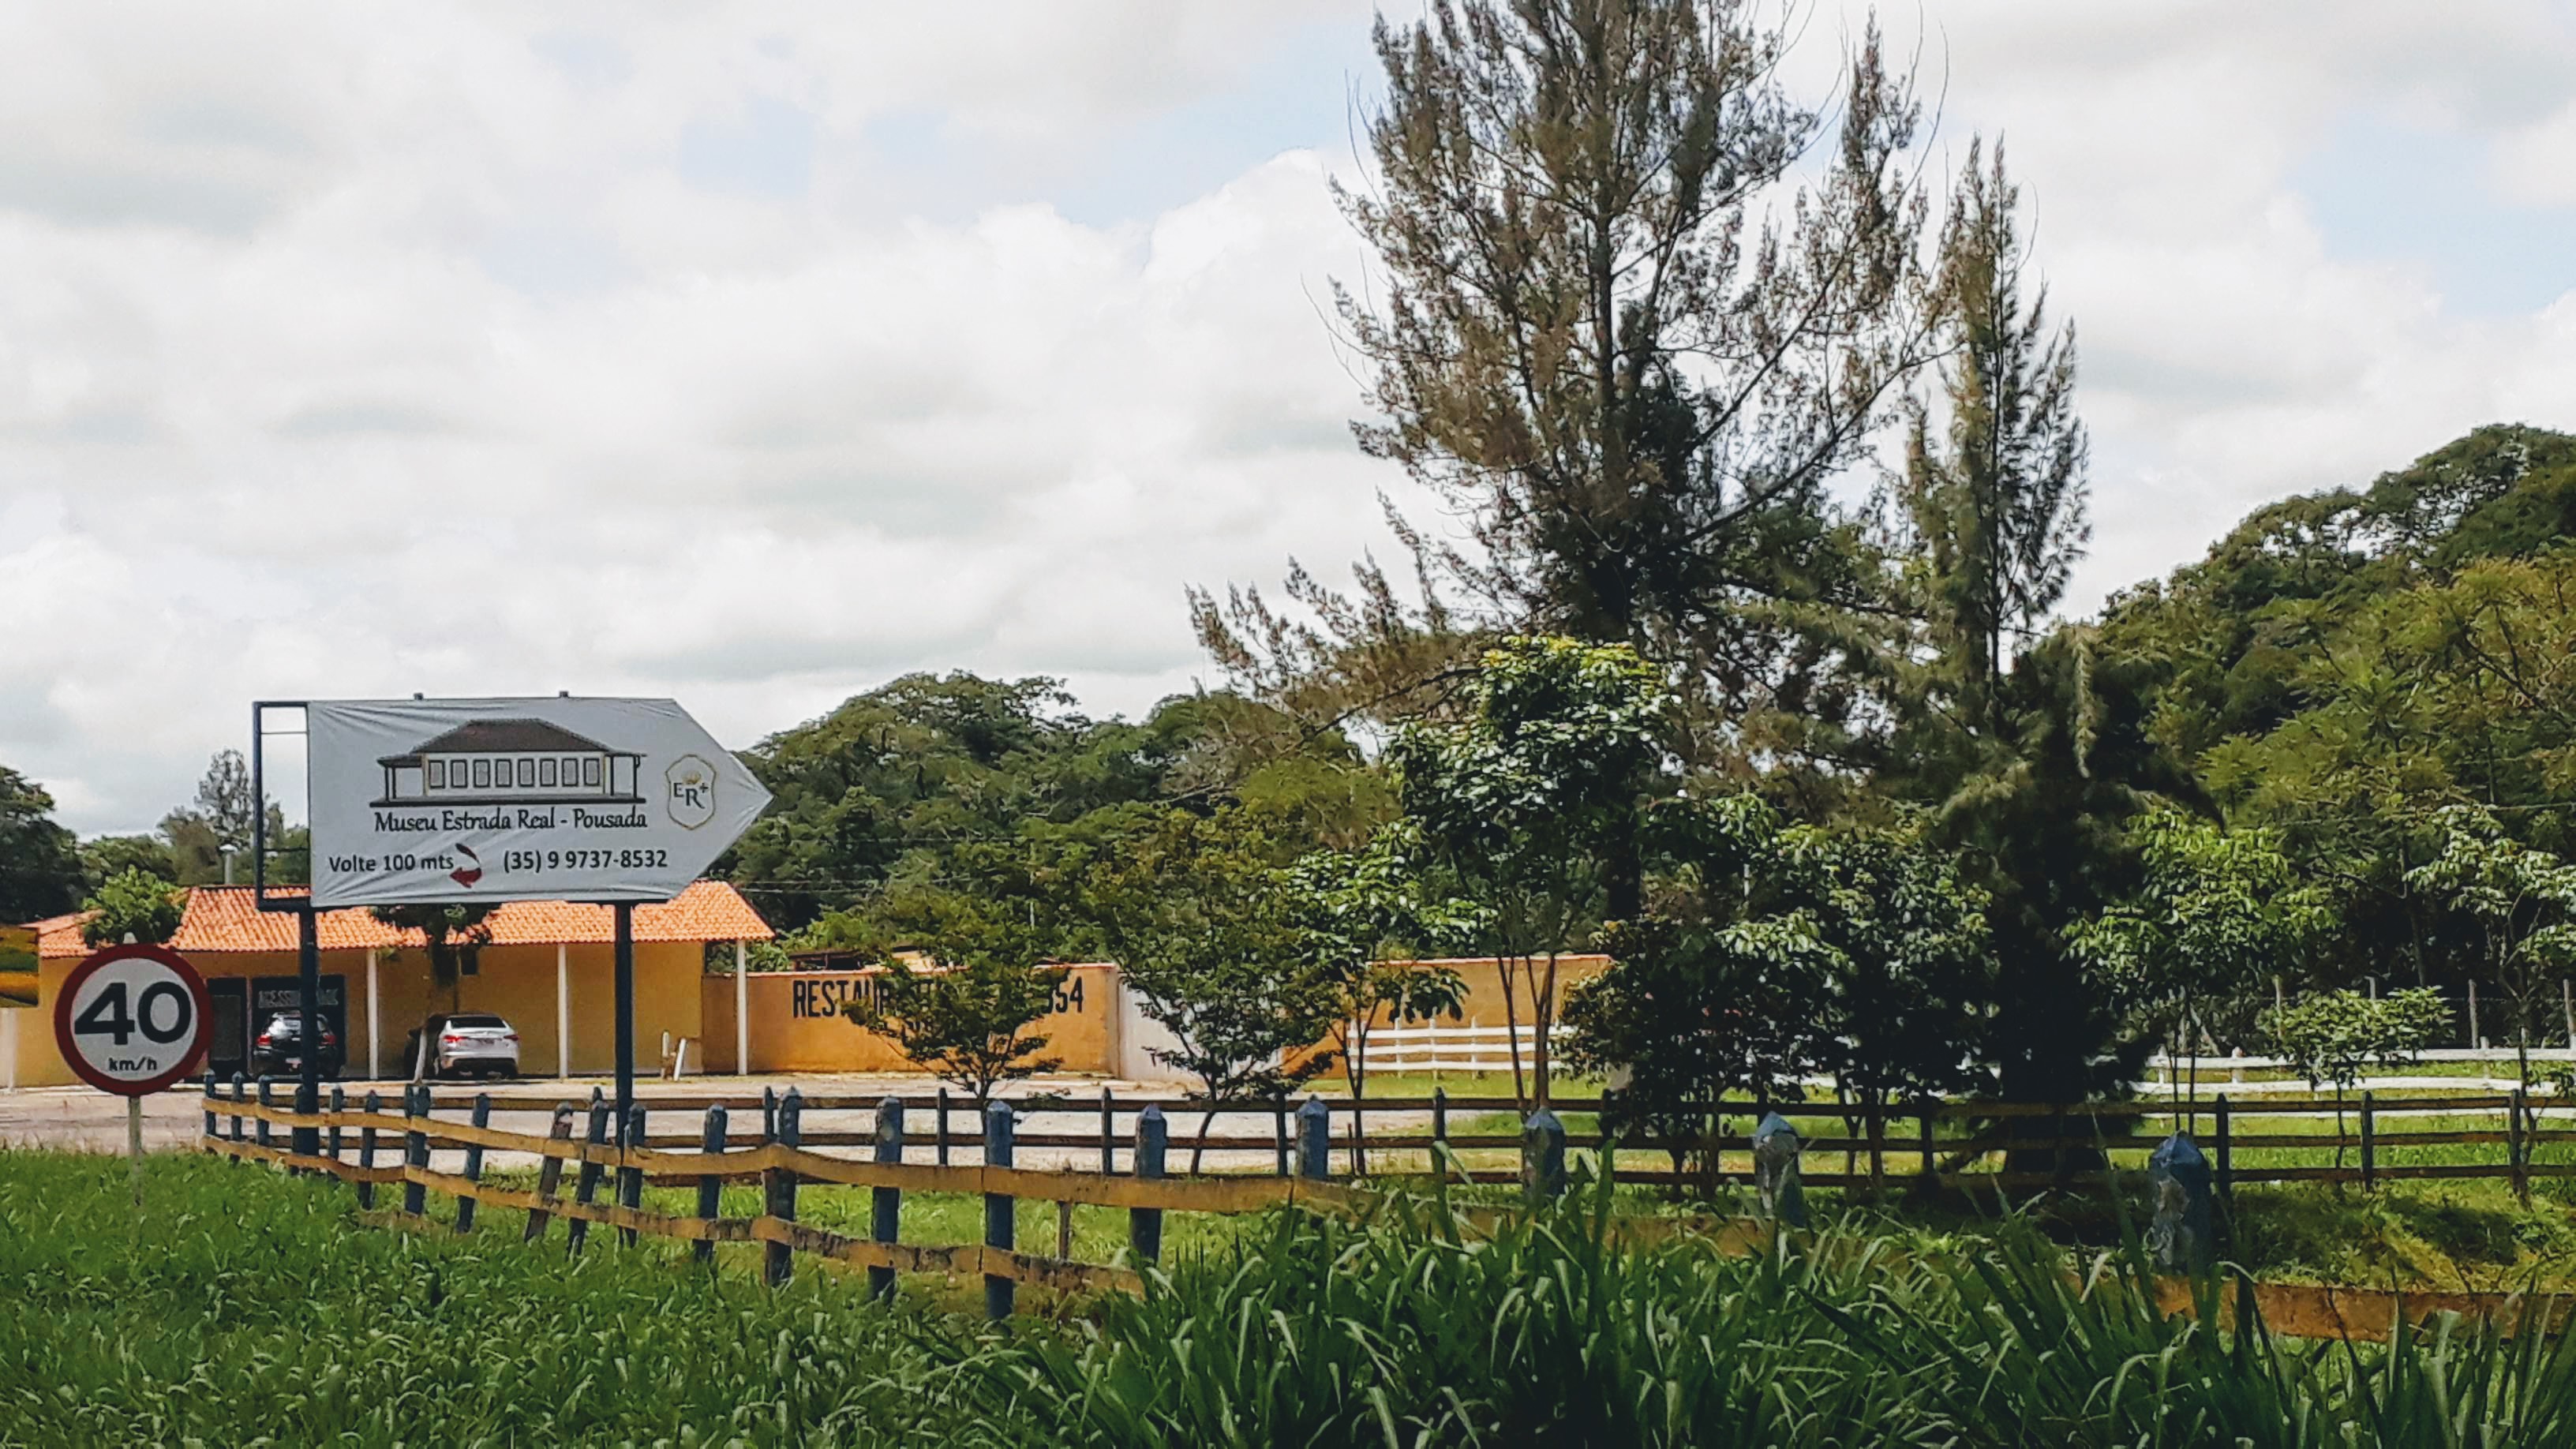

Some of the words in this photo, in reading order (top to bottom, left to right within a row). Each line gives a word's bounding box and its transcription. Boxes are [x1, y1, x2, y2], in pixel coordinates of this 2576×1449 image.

[374, 812, 437, 832] Museu
[442, 807, 511, 829] Estrada
[518, 807, 555, 829] Real
[572, 804, 647, 829] Pousada
[329, 855, 376, 871] Volte
[384, 855, 415, 870] 100
[421, 855, 454, 870] mts
[504, 850, 541, 873] (35)
[548, 851, 559, 868] 9
[565, 849, 668, 868] 9737-8532
[75, 981, 191, 1045] 40
[109, 1057, 157, 1072] km/h
